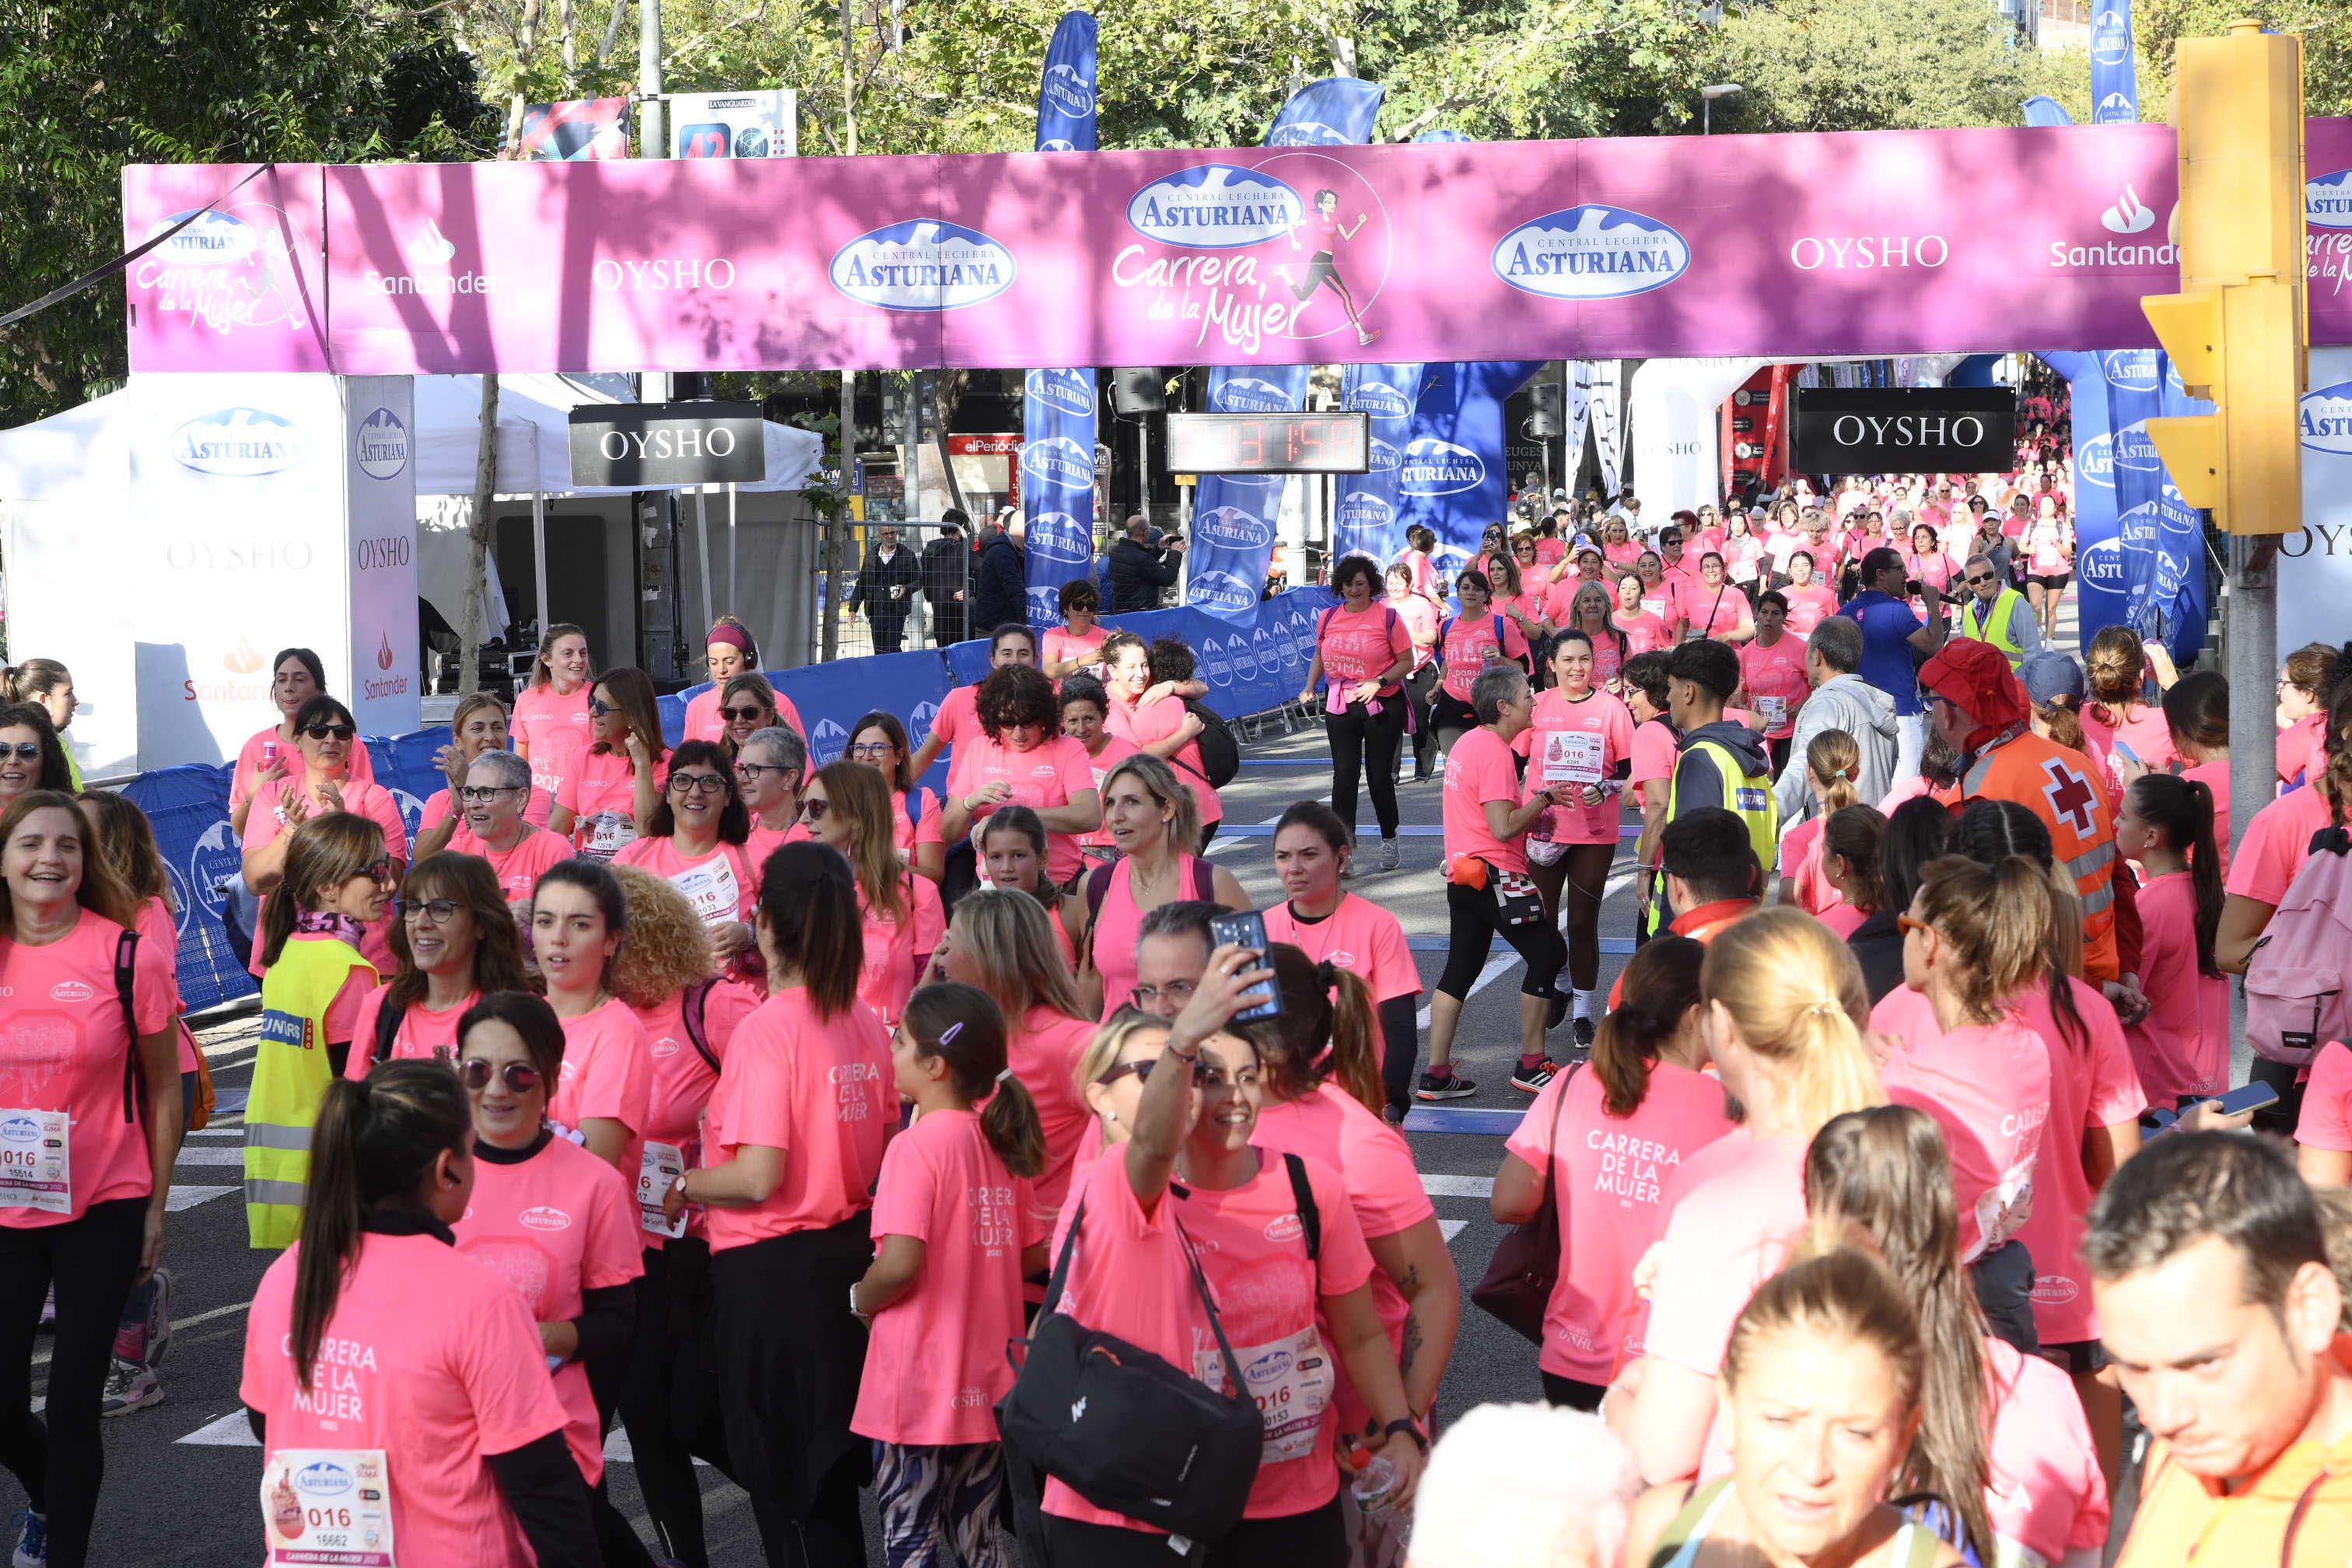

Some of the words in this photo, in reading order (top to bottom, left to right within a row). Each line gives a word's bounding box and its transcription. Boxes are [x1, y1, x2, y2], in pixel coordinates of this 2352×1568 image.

[717, 99, 755, 107] VANGUARDIA
[1140, 196, 1291, 227] ASTURIANA
[1167, 193, 1223, 201] CENTRAL
[1229, 192, 1285, 201] LECHERA
[873, 250, 931, 260] CENTRAL
[937, 250, 996, 259] LECHERA
[1538, 237, 1599, 247] CENTRAL
[1605, 236, 1668, 246] LECHERA
[1790, 235, 1948, 269] OYSHO
[844, 254, 1002, 287] ASTURIANA
[1112, 243, 1258, 287] Carrera
[1507, 241, 1675, 275] ASTURIANA
[2322, 257, 2336, 277] la
[591, 258, 735, 291] OYSHO
[1148, 290, 1173, 320] de
[1181, 291, 1199, 318] la
[1196, 285, 1312, 355] Mujer
[1033, 374, 1090, 411] ASTURIANA
[600, 427, 735, 460] OYSHO
[1833, 415, 1983, 447] OYSHO
[360, 436, 405, 461] ASTURIANA
[2084, 451, 2112, 473] AST
[1030, 448, 1090, 482] ASTURIANA
[359, 535, 409, 569] OYSHO
[1027, 526, 1087, 556] ASTURIANA
[1334, 656, 1364, 665] DORSAL
[365, 676, 408, 700] Santander
[1587, 1129, 1680, 1167] CARRERA
[1602, 1153, 1627, 1176] DE
[1633, 1160, 1657, 1183] LA
[1594, 1173, 1660, 1205] MUJER
[994, 1208, 1010, 1226] LA
[331, 1366, 359, 1393] LA
[293, 1388, 362, 1422] MUJER
[309, 1507, 351, 1527] 016
